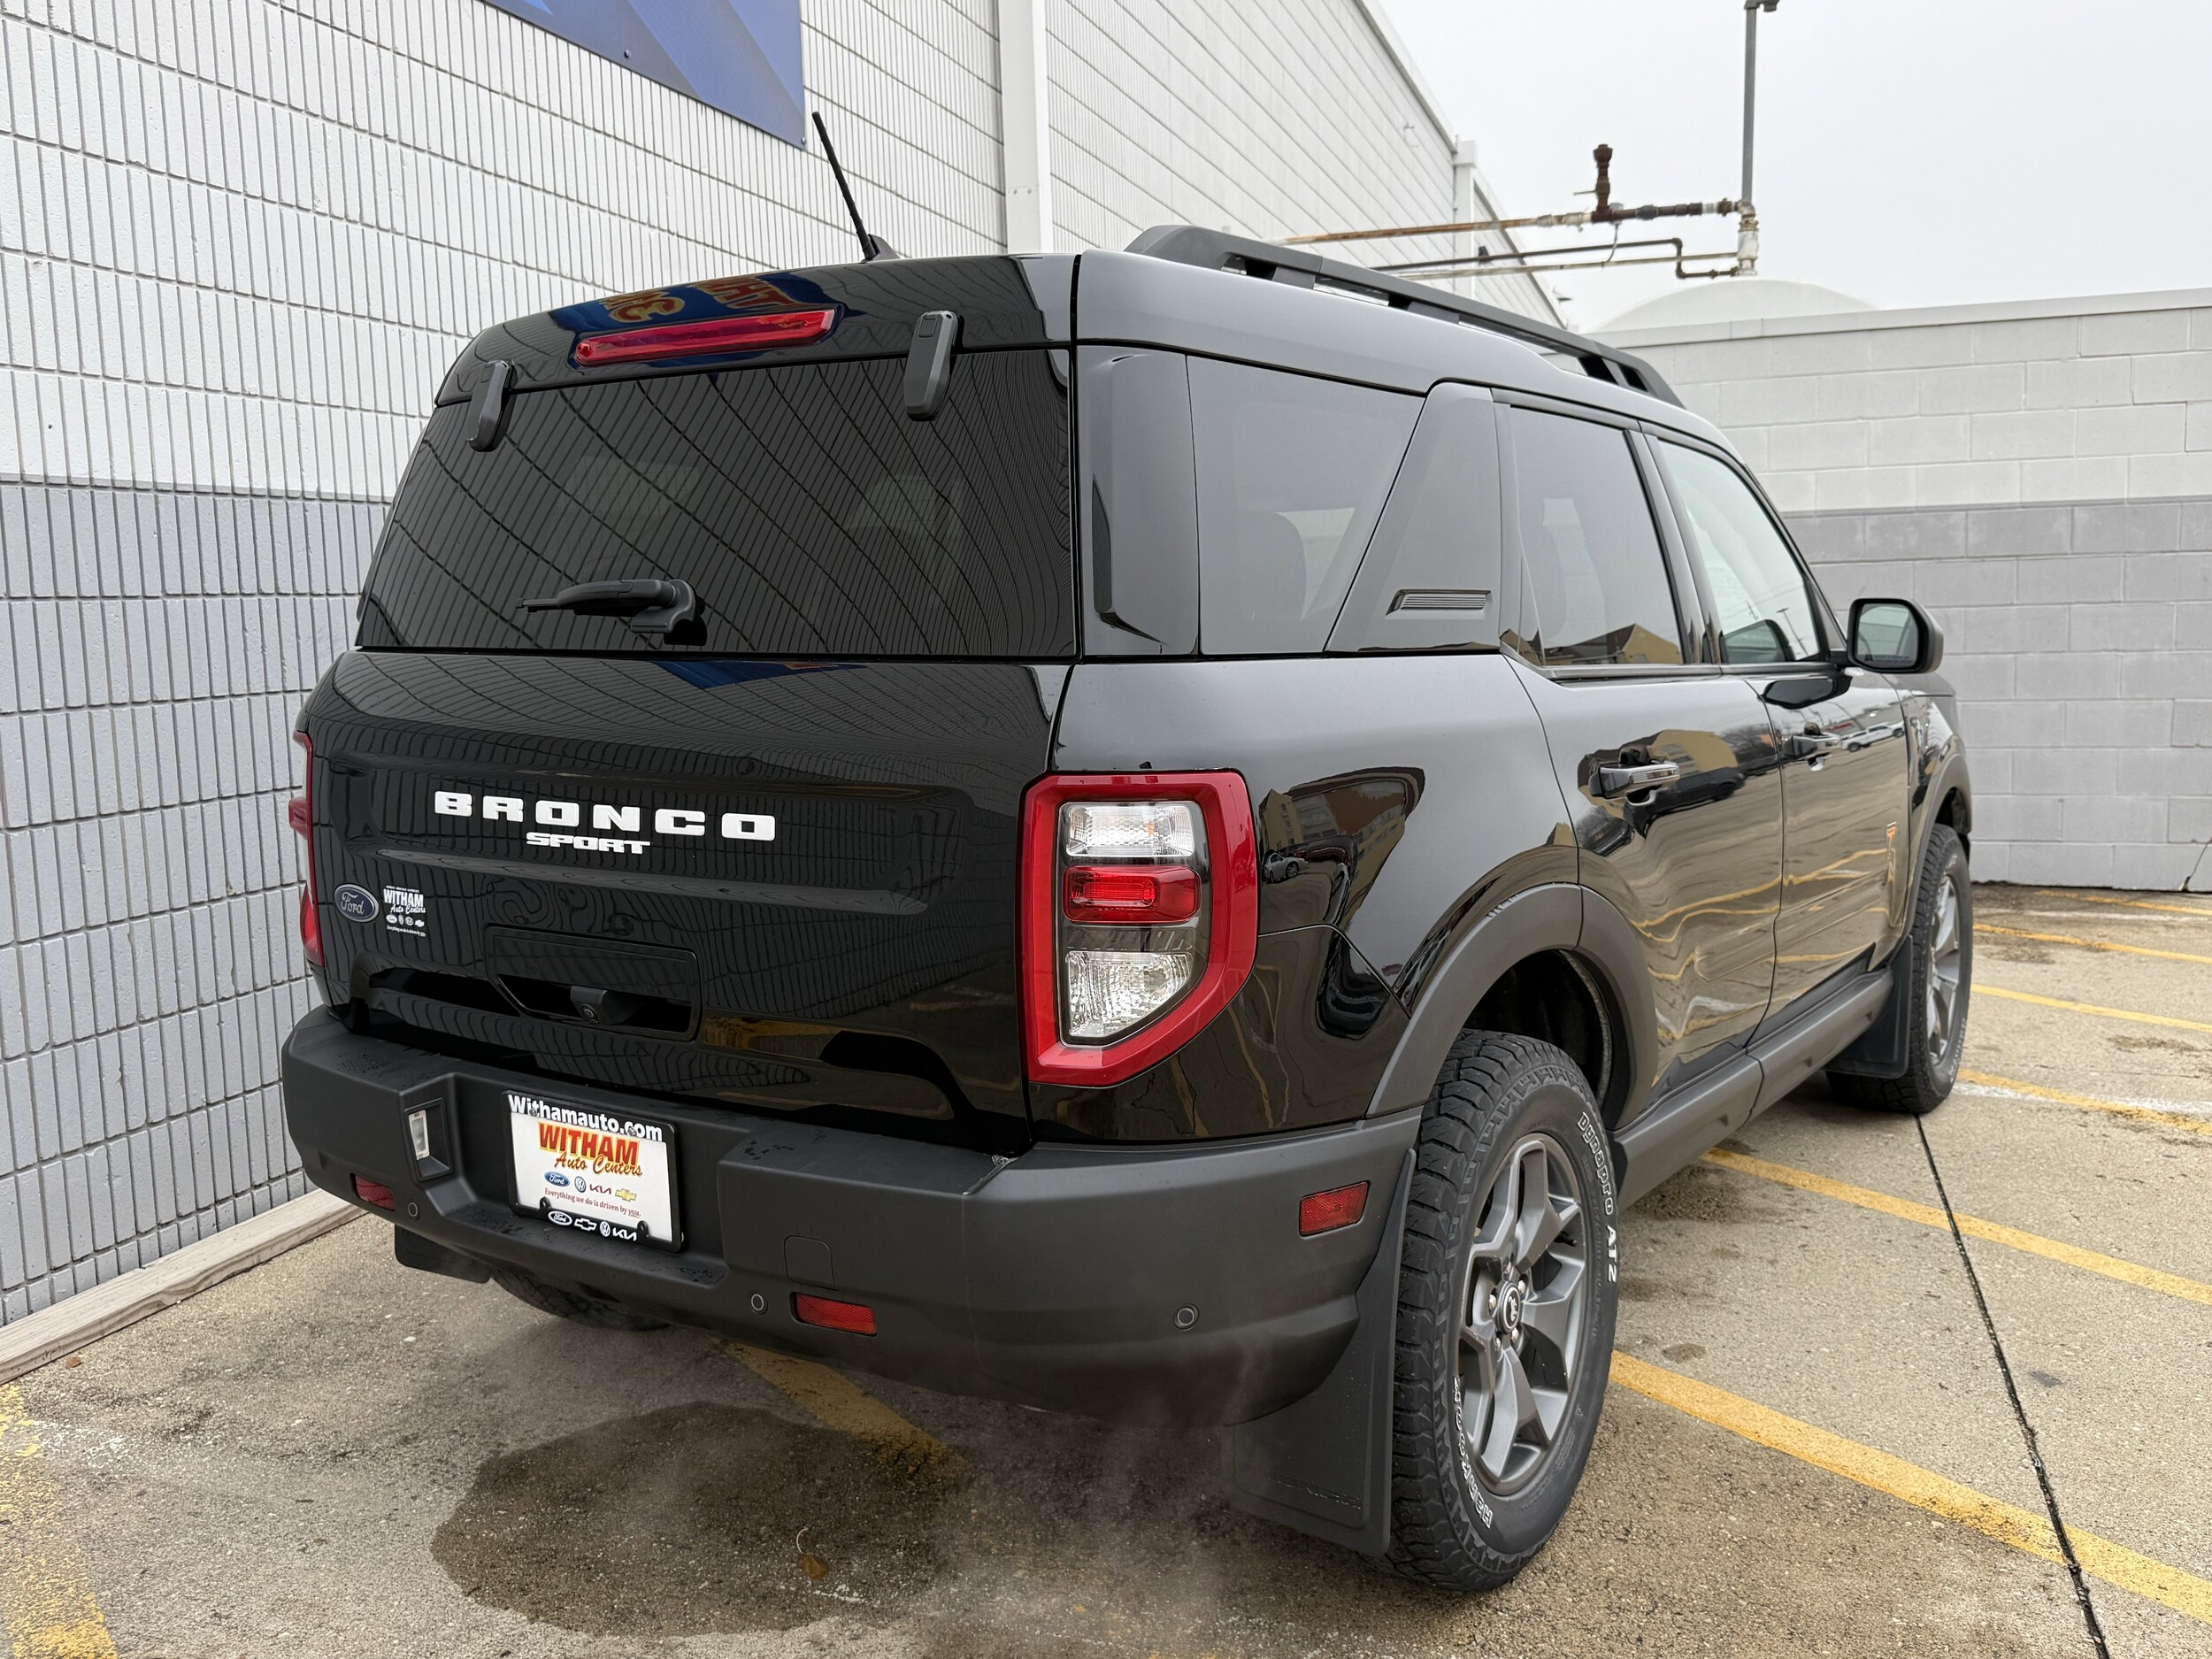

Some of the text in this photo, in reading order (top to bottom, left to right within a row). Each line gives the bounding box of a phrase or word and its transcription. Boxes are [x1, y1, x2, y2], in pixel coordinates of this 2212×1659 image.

[434, 790, 776, 841] BRONCO
[526, 832, 651, 855] SPORT
[383, 888, 424, 908] WITHAM
[508, 1094, 663, 1142] Withamauto.com
[539, 1122, 640, 1165] WITHAM
[554, 1152, 643, 1177] Auto Centers
[544, 1187, 575, 1202] Everything
[585, 1196, 594, 1205] do
[600, 1201, 619, 1212] driven
[619, 1204, 627, 1215] by
[1577, 1111, 1614, 1216] Dynapro
[1606, 1225, 1617, 1283] AT2
